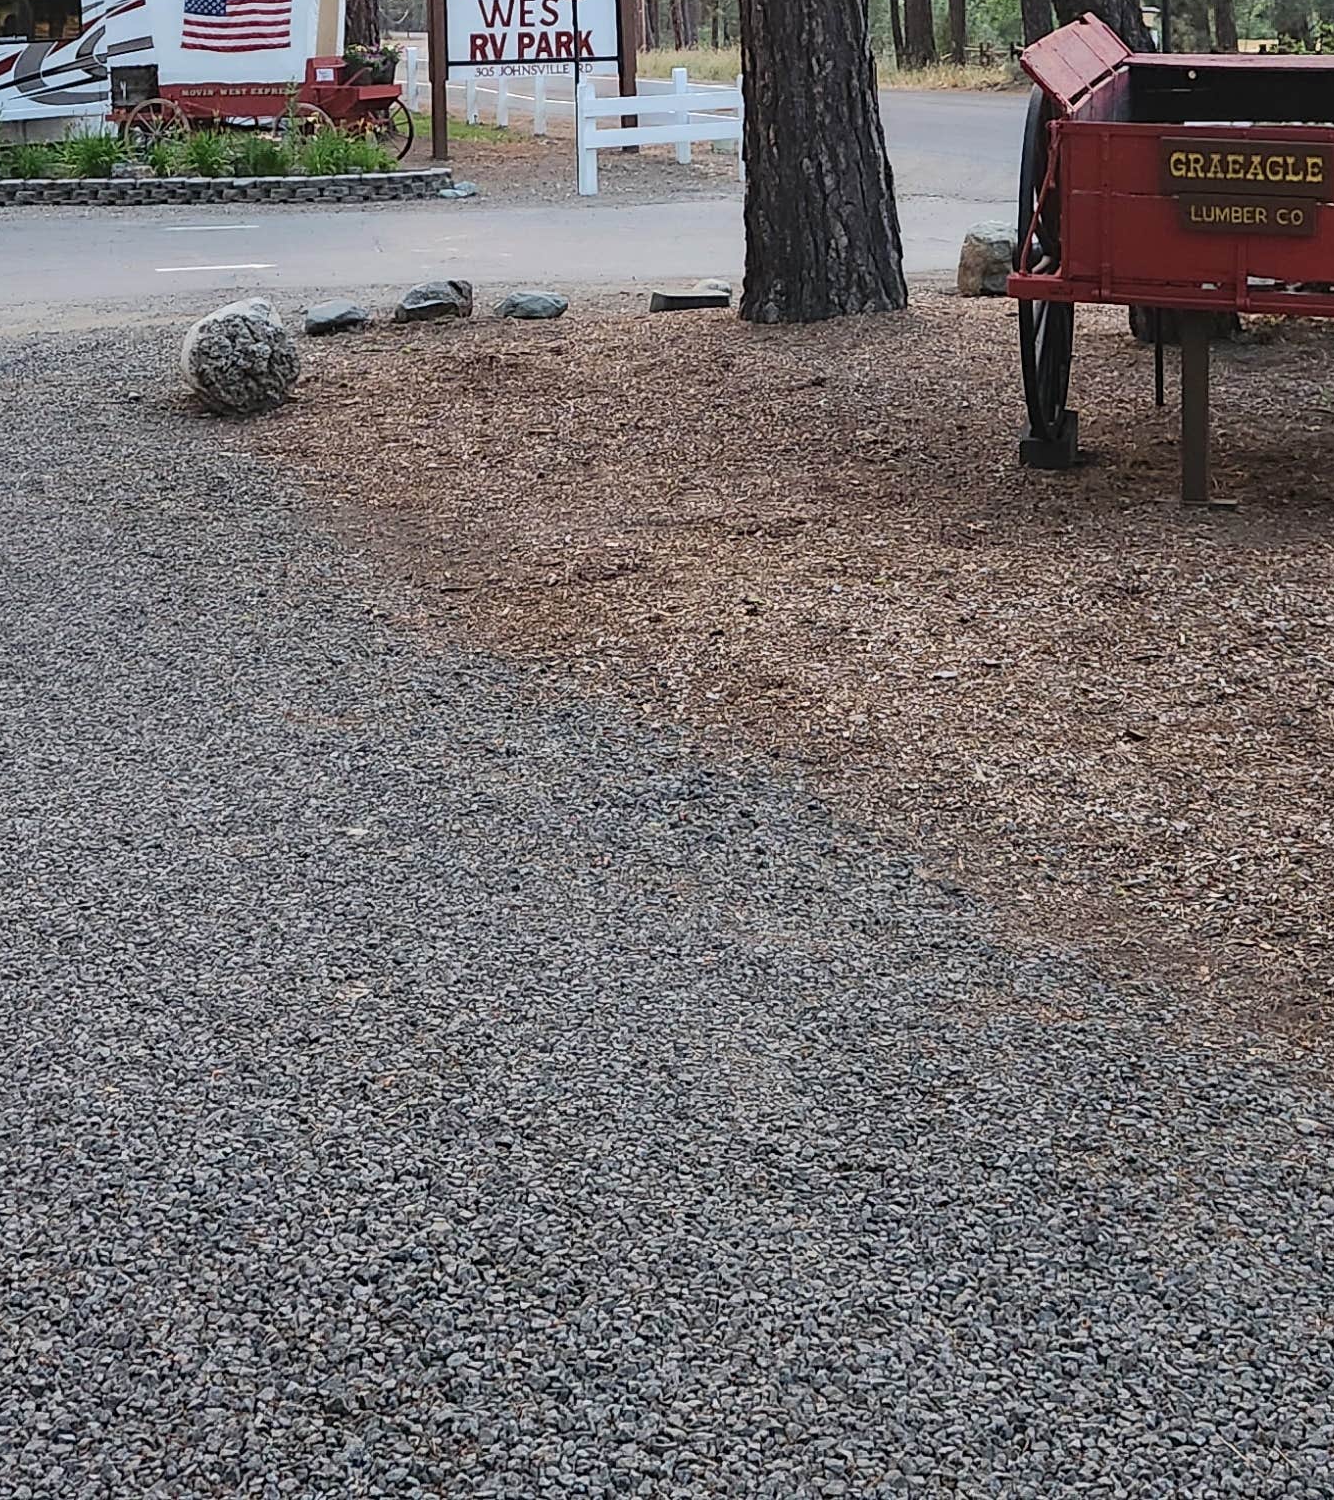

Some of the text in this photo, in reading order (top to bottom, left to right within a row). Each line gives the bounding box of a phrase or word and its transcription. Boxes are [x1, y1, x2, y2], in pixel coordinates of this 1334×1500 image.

[470, 30, 595, 61] RV PARK
[475, 63, 593, 77] 305 JOHNSVILLE RD
[220, 87, 247, 96] WEST
[1170, 152, 1323, 183] GRAEAGLE
[1191, 205, 1304, 226] LUMBER CO
